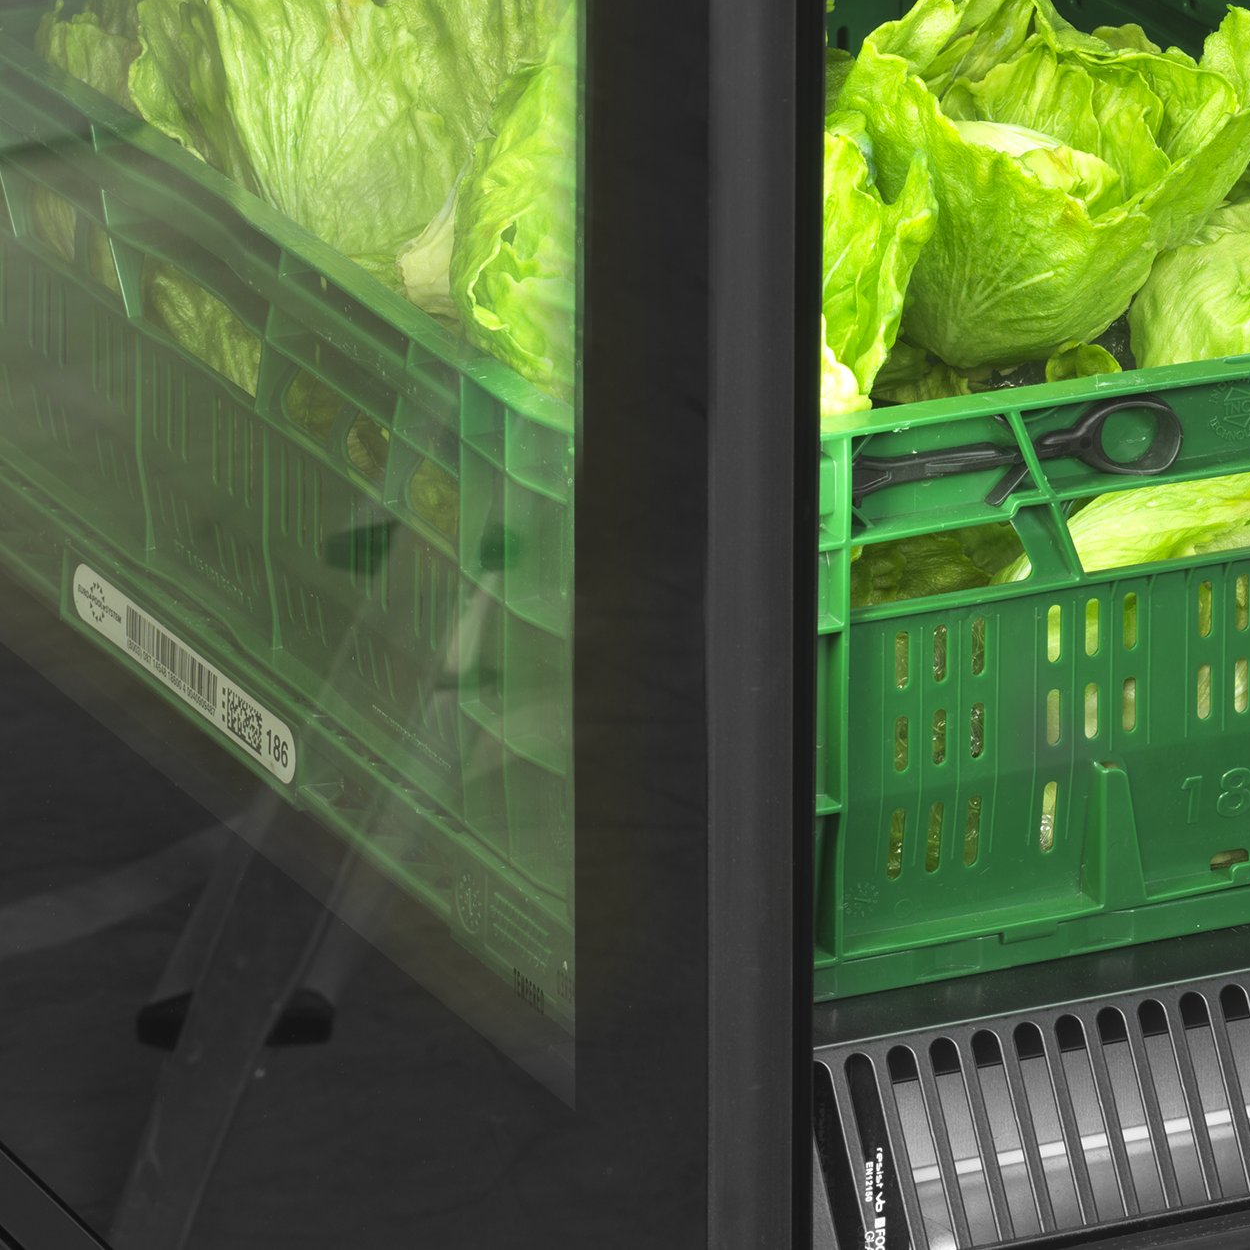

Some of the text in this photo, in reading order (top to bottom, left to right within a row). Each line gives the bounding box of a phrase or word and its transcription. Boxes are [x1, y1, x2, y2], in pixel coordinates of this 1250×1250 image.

[265, 728, 289, 769] 186
[513, 967, 545, 1016] TEMPERED
[865, 1161, 874, 1203] EN12150
